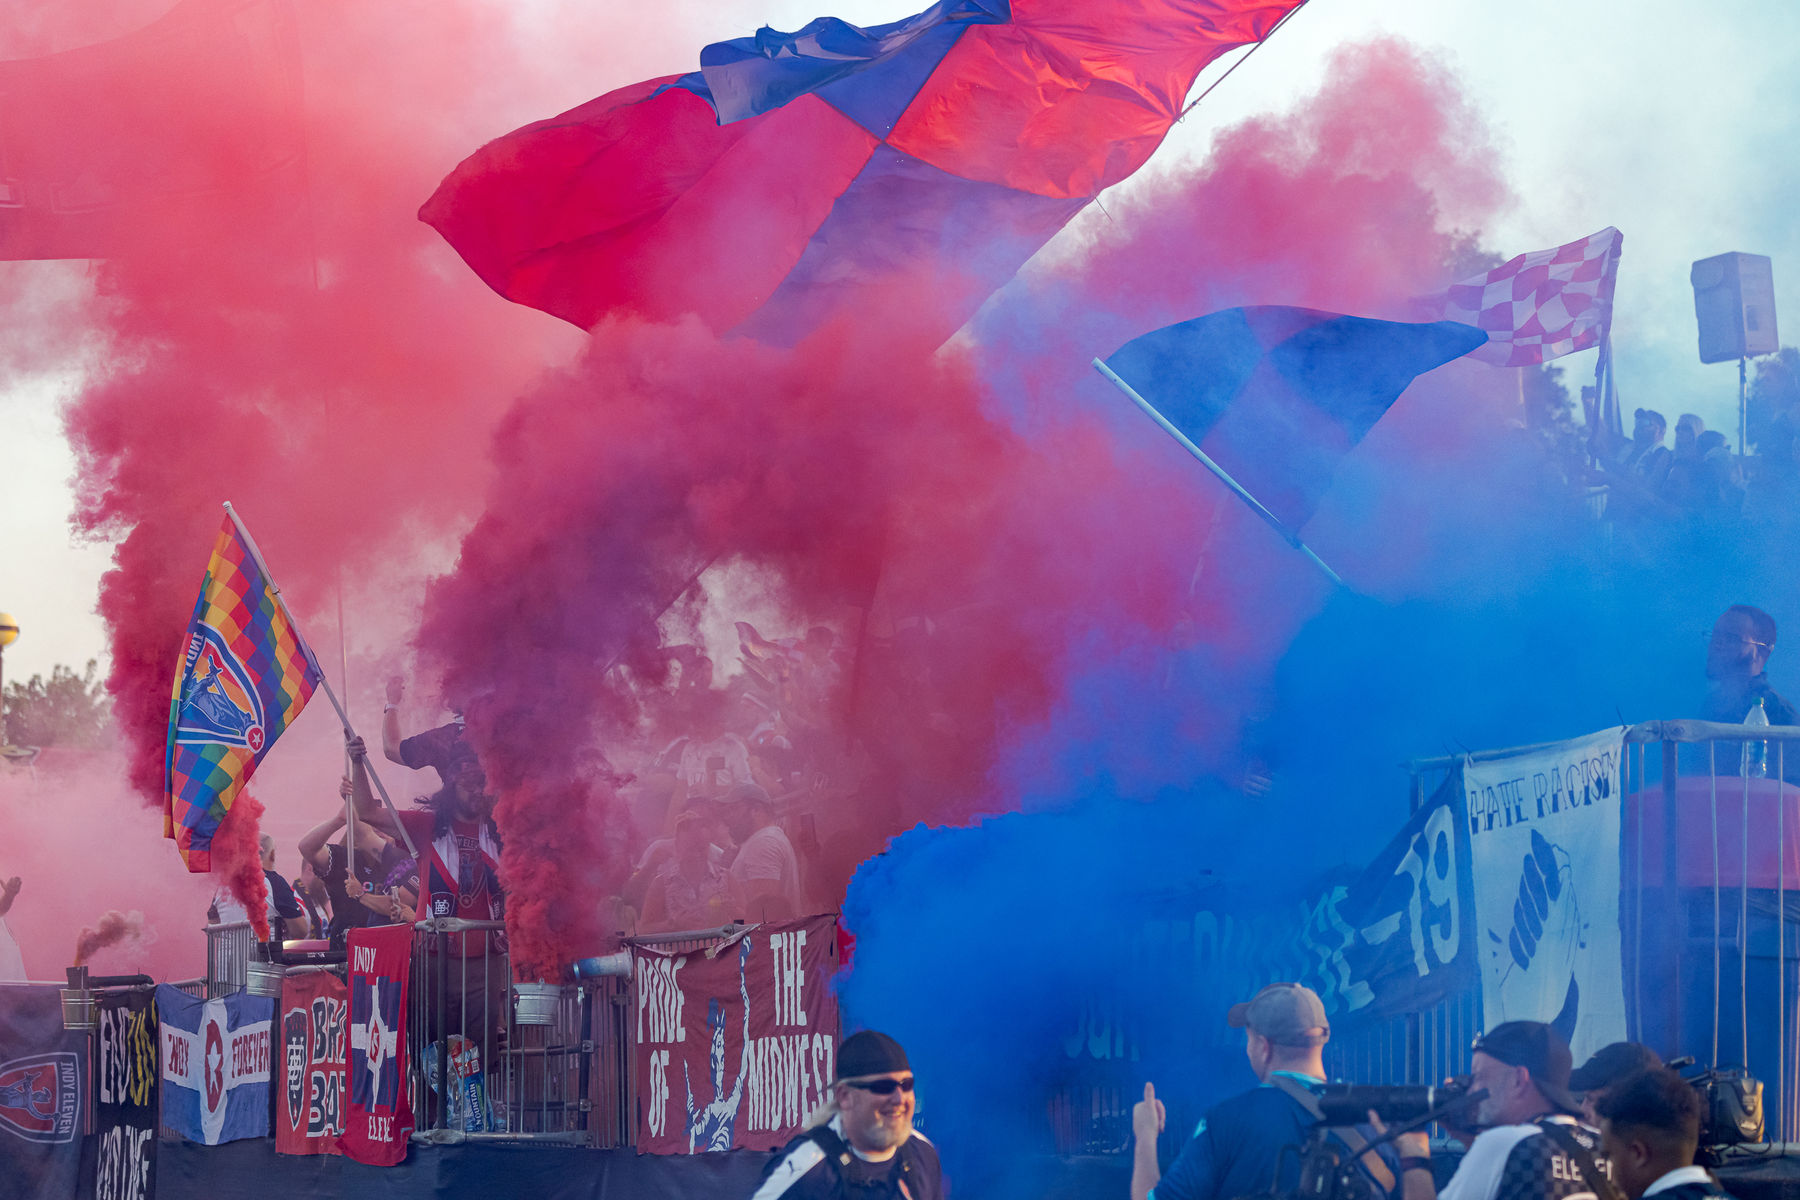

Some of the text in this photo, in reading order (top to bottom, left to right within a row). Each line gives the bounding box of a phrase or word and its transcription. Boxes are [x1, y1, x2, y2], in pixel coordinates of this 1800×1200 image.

[1470, 777, 1529, 835] HATE
[353, 945, 377, 974] INDY
[769, 929, 808, 1026] THE
[637, 956, 687, 1044] PRIDE
[232, 1030, 271, 1079] FOREVER
[648, 1050, 670, 1138] OF
[748, 1033, 834, 1131] MIDWEST
[58, 1061, 76, 1134] INDY ELEVEN
